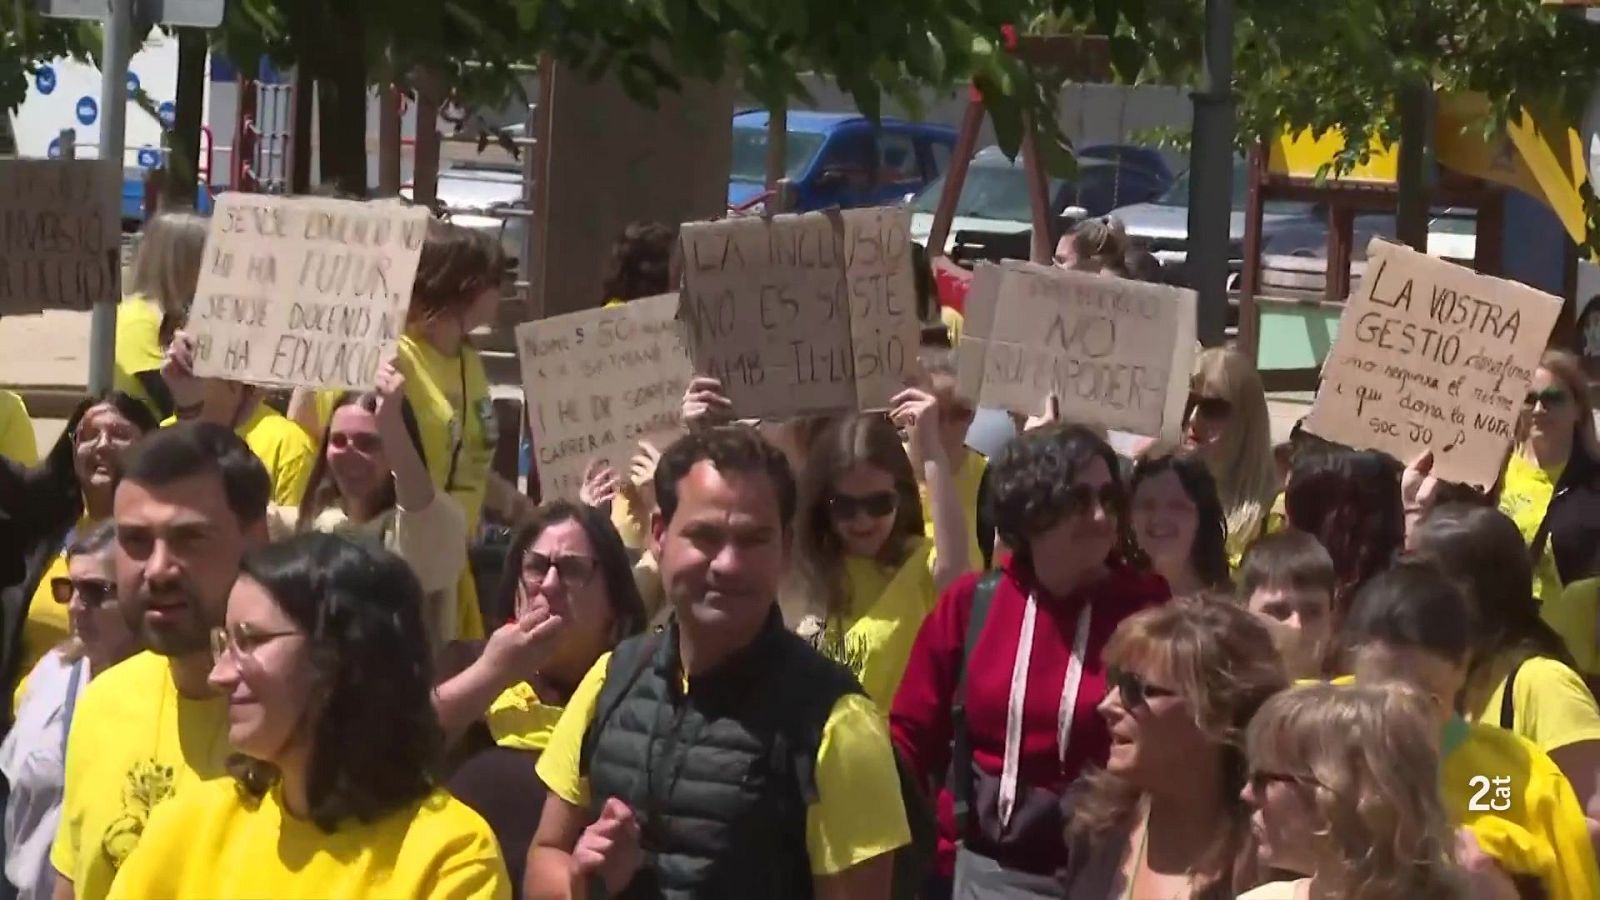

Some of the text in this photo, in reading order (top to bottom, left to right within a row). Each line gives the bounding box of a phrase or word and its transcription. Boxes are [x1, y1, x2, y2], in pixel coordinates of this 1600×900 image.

[693, 233, 747, 272] LA
[693, 288, 735, 340] NO
[760, 284, 800, 330] ES
[1369, 260, 1521, 345] LA VOSTRA
[1045, 313, 1117, 358] NO
[1354, 311, 1463, 367] GESTIÓ
[1399, 393, 1446, 421] dona
[1409, 421, 1433, 445] JO
